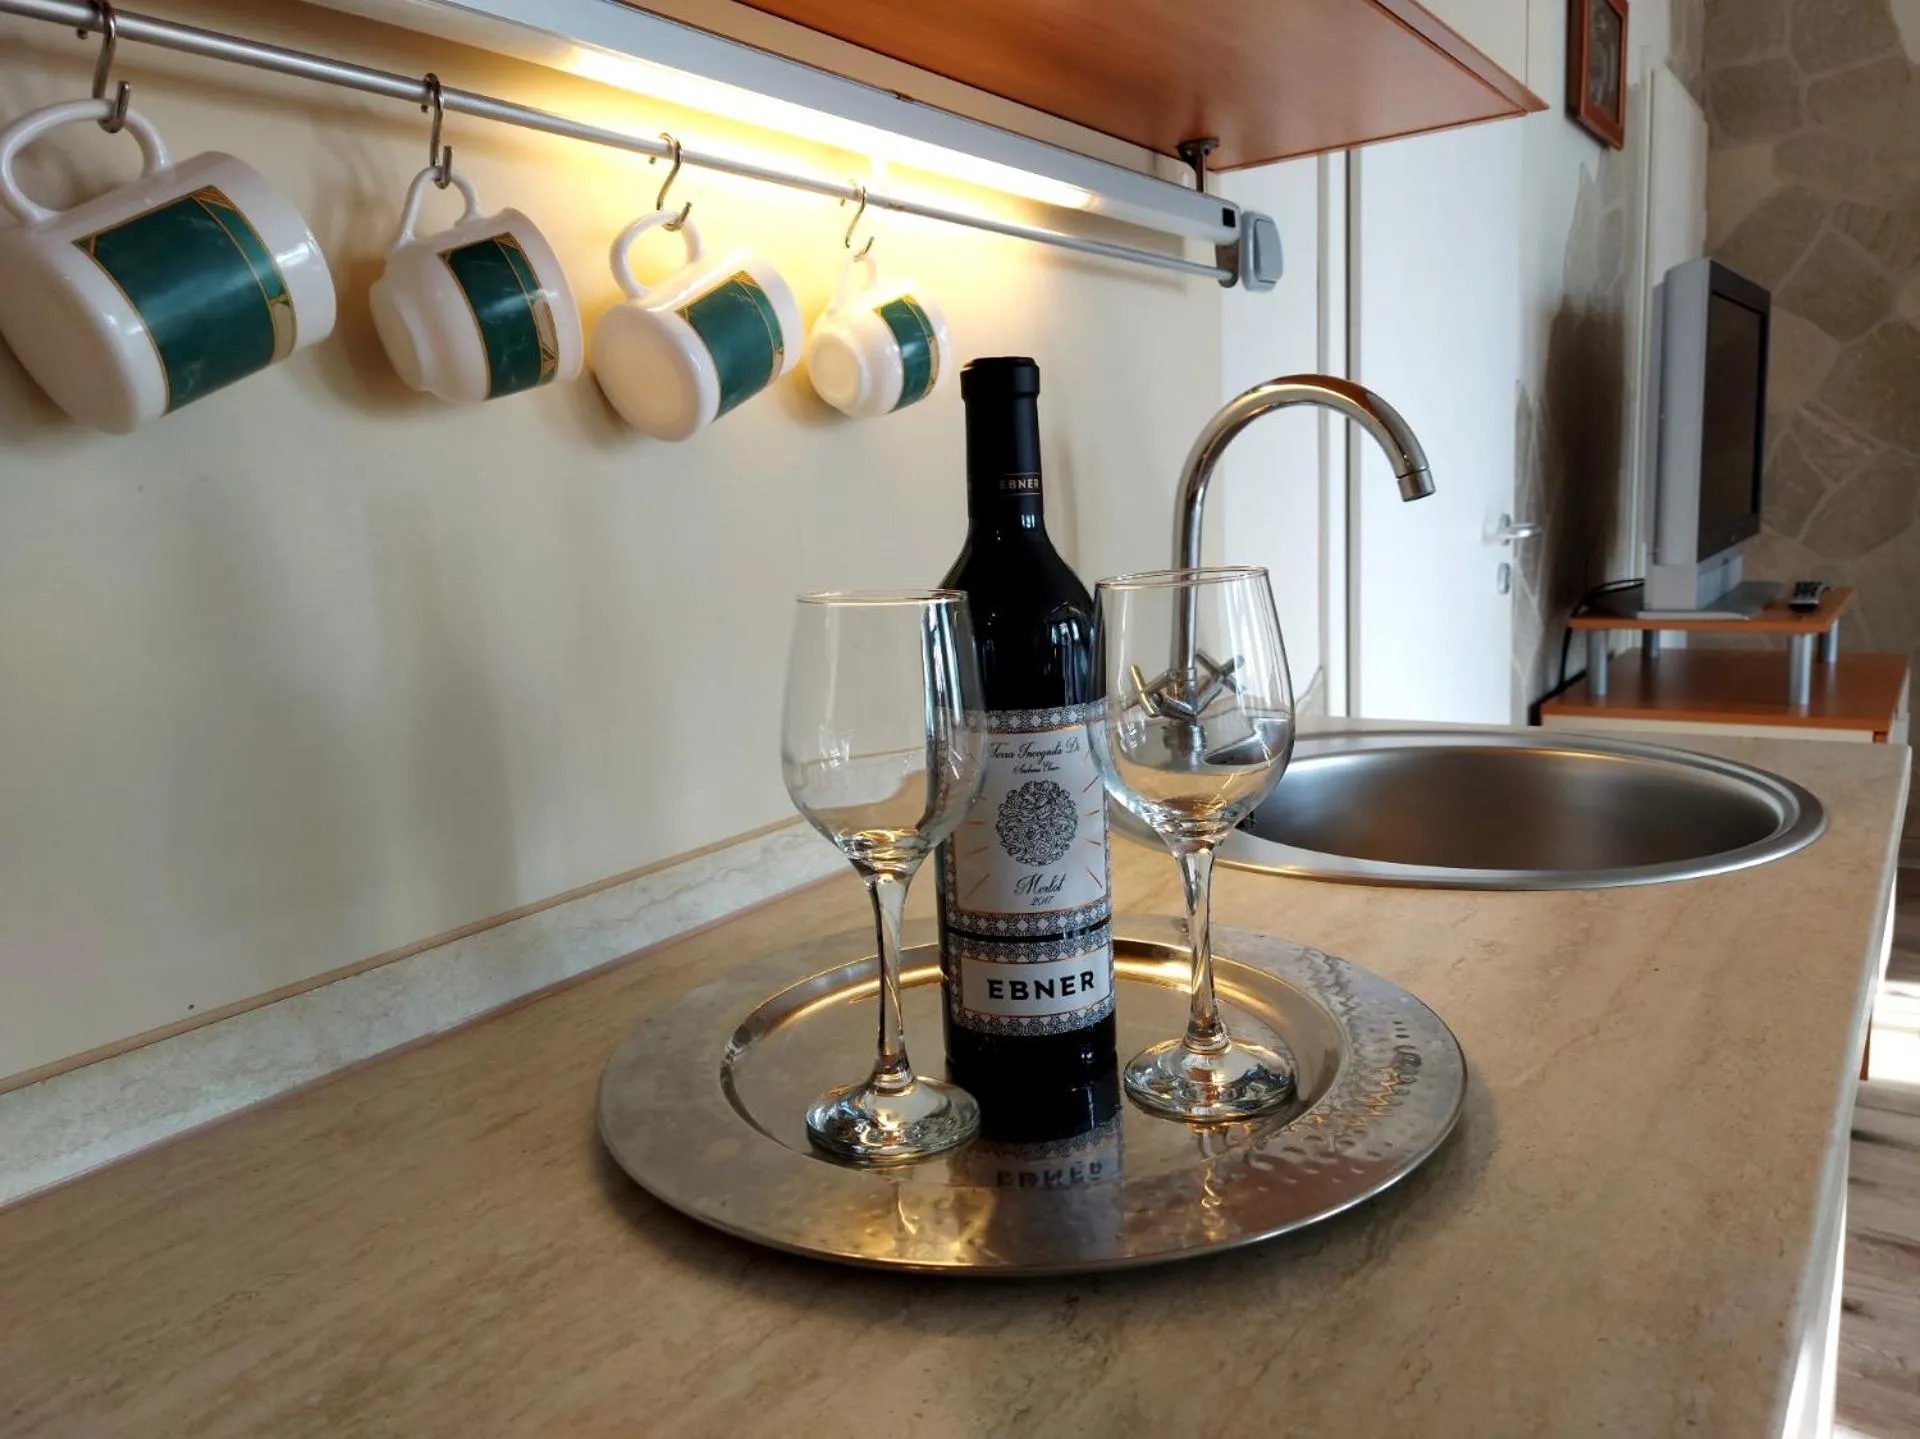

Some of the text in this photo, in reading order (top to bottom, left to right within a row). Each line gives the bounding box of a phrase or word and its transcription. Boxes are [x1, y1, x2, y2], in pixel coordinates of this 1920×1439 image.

[999, 478, 1039, 489] EBNER
[1013, 872, 1066, 895] Merlot
[986, 971, 1095, 1001] EBNER
